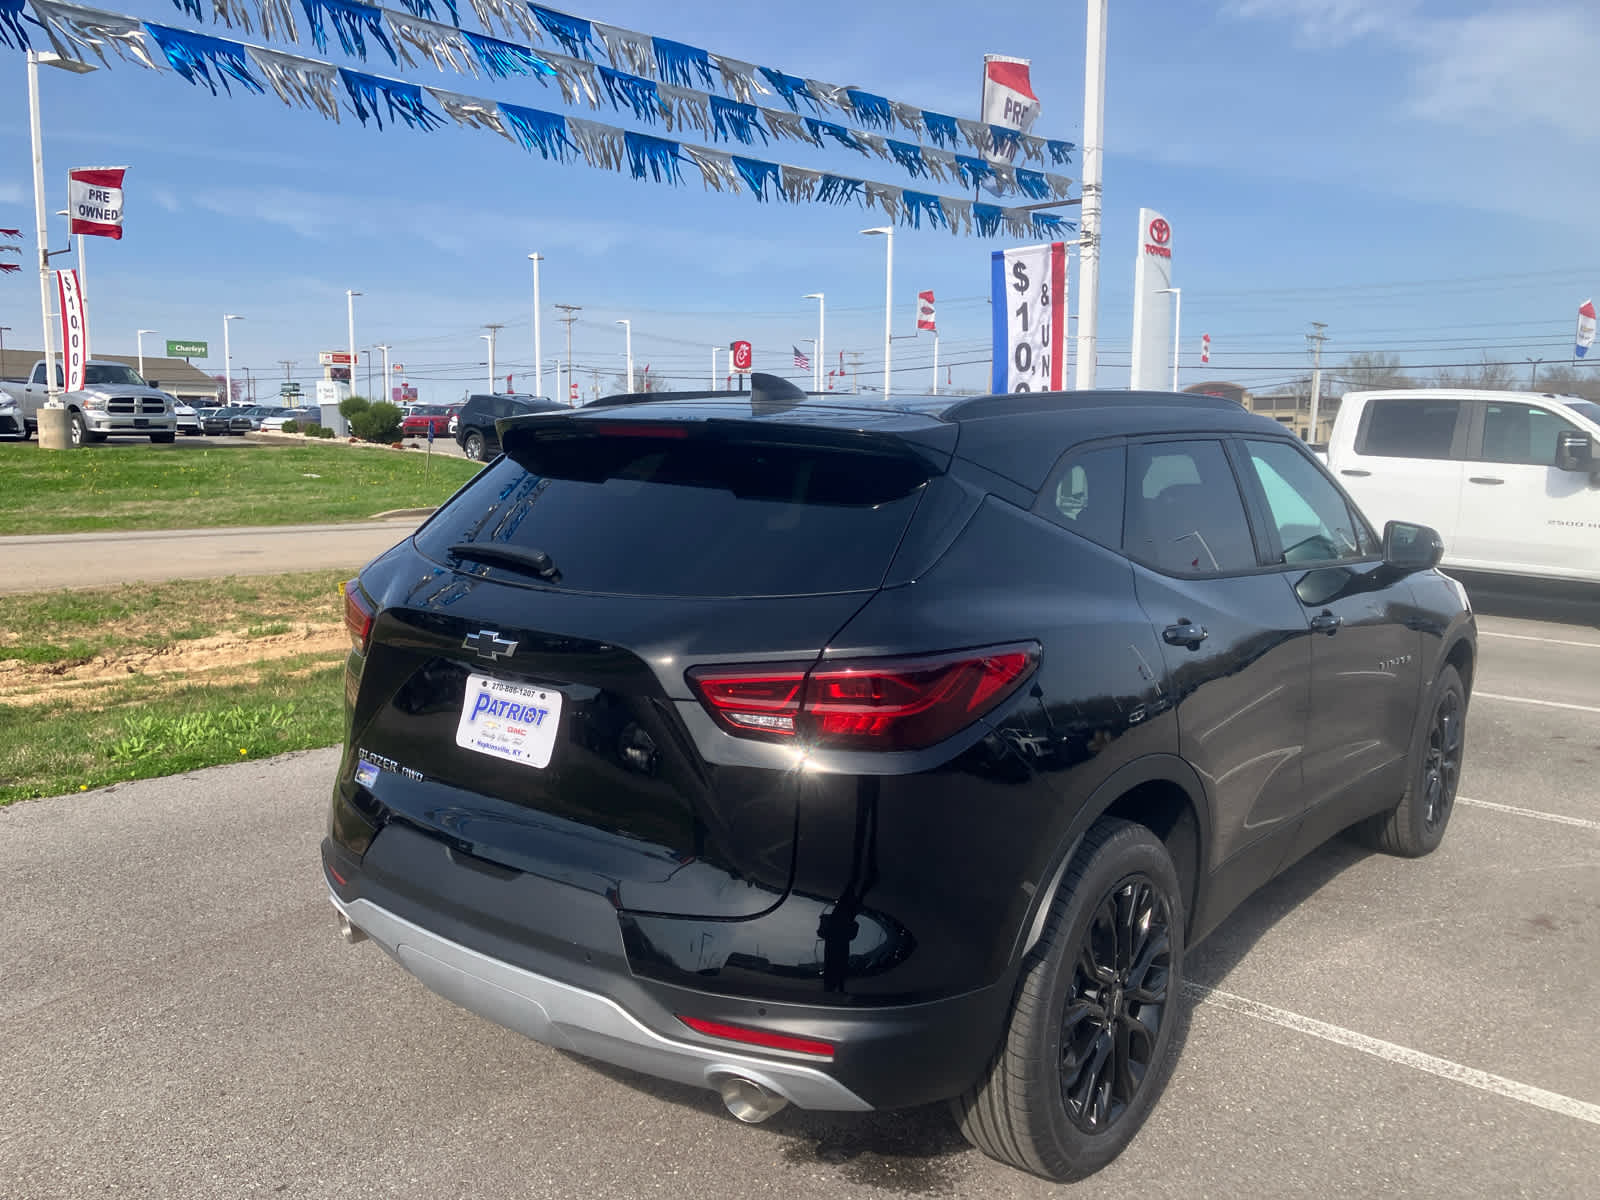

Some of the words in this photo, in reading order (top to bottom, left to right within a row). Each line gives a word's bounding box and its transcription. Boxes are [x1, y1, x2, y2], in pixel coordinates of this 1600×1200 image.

[88, 188, 110, 203] PRE
[78, 204, 118, 221] OWNED
[1144, 243, 1172, 260] TOYOTA
[175, 344, 206, 353] Charleys
[1548, 519, 1584, 528] 2500
[470, 692, 549, 726] PATRIOT
[506, 726, 528, 736] GMC
[512, 747, 523, 757] KY
[358, 747, 399, 774] BLAZER
